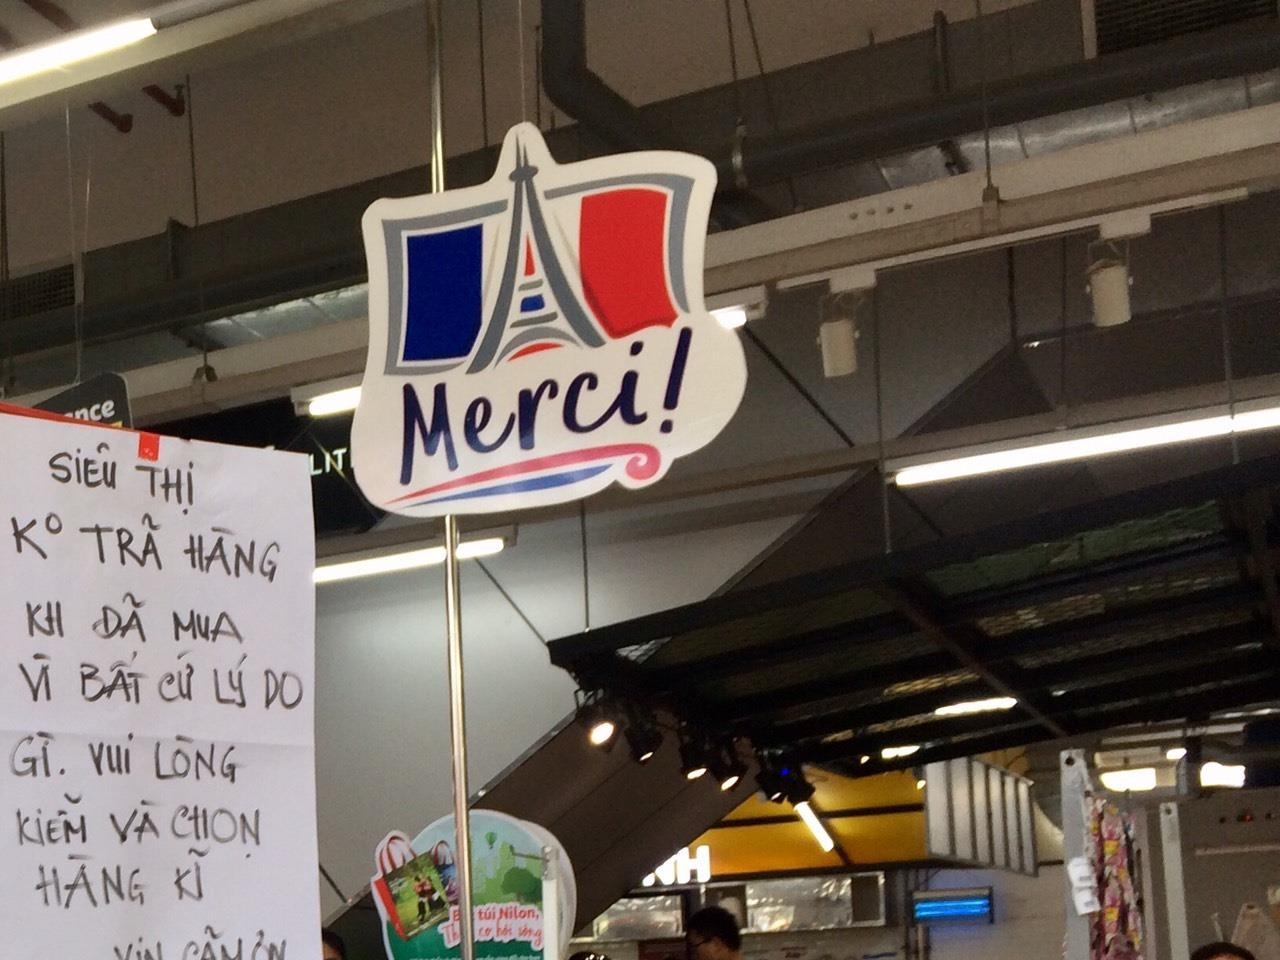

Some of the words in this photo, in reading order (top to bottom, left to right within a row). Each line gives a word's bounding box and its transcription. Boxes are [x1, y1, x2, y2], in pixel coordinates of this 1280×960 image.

[400, 327, 692, 484] Merci!
[173, 608, 244, 643] MUA
[264, 668, 303, 710] DO
